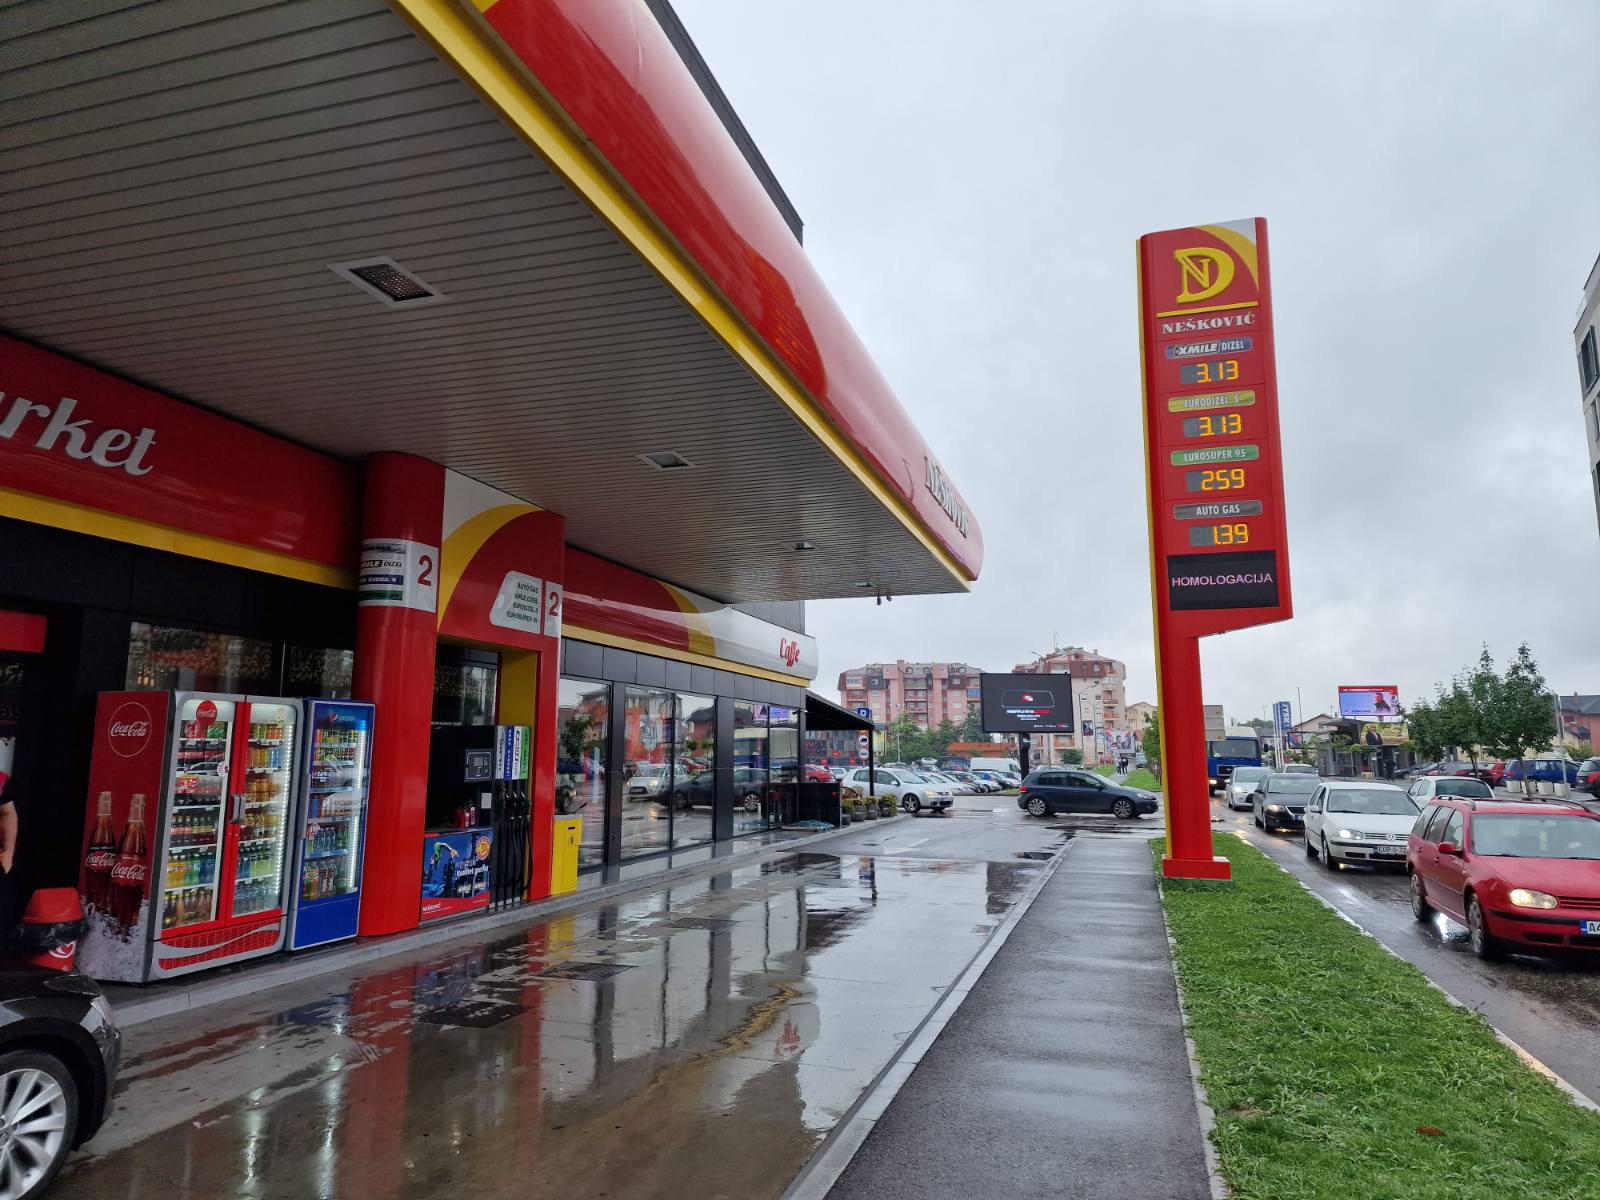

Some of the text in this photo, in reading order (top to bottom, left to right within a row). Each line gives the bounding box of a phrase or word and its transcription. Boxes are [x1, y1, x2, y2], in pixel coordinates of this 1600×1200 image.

[1162, 312, 1256, 334] NEŠKOVIĆ
[1221, 341, 1244, 351] DIZEL
[1196, 360, 1239, 383] 3.13
[1184, 395, 1229, 408] EURODIZEL
[0, 391, 156, 475] rket
[1200, 413, 1242, 437] 3.13
[1184, 449, 1246, 462] EUROSUPER 95
[1196, 504, 1240, 516] AUTO GAS
[417, 554, 433, 587] 2
[1172, 573, 1274, 586] HOMOLOGACIJA
[548, 591, 559, 617] 2
